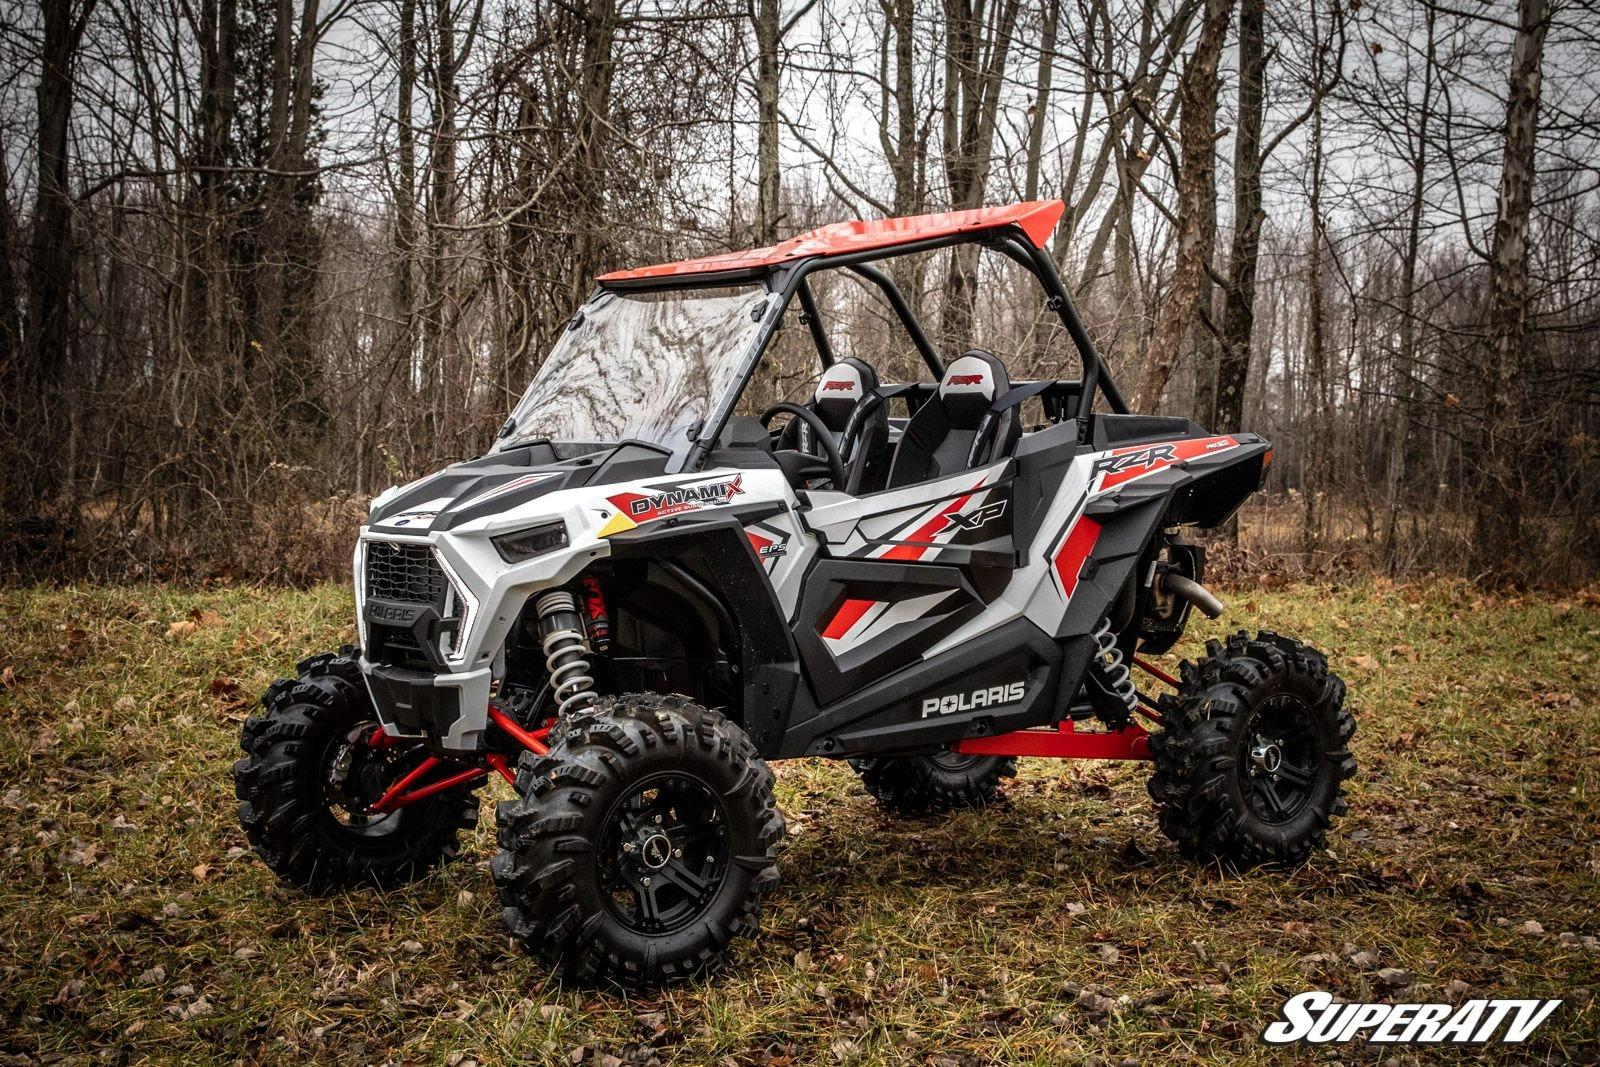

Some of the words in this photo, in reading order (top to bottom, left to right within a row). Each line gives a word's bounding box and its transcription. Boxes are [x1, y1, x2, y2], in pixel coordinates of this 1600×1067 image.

[1088, 444, 1178, 482] RZR
[629, 472, 745, 515] DYNAMIX
[657, 506, 683, 516] ACTIVE
[929, 499, 1008, 539] XP
[759, 543, 787, 554] EPS
[921, 681, 1025, 718] POLARIS
